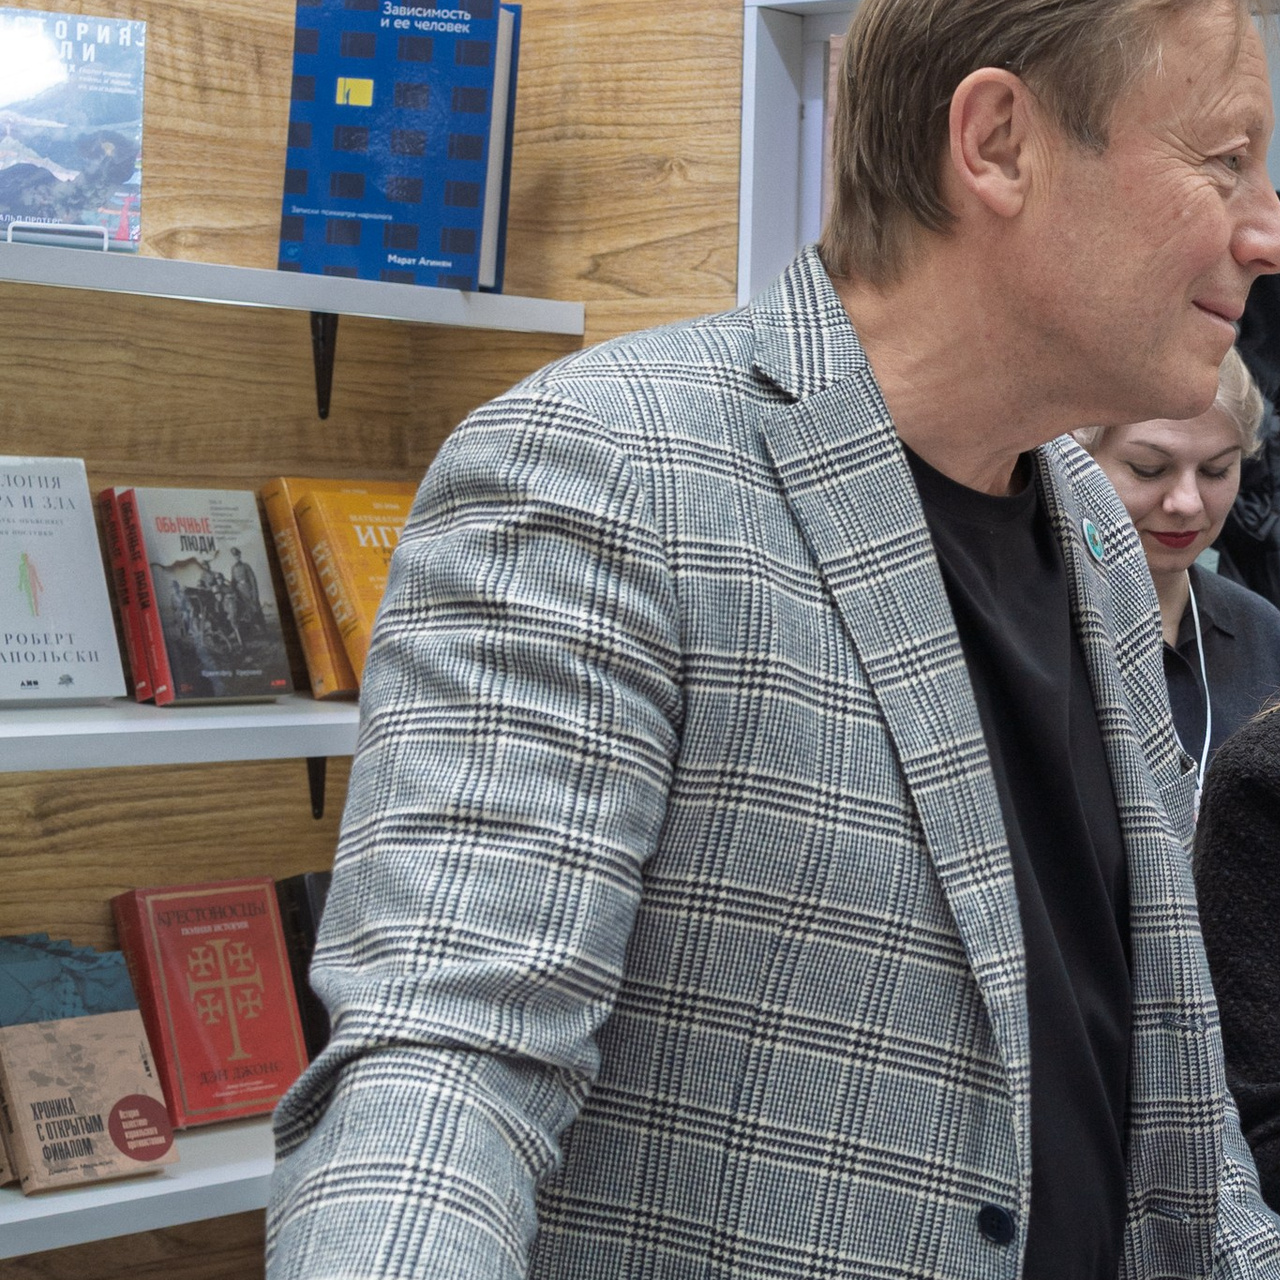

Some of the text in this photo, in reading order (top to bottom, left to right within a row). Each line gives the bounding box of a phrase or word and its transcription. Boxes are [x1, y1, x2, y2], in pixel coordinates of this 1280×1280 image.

[382, 1, 471, 21] Зависимость
[380, 19, 470, 33] и ее человек
[387, 254, 416, 266] Марат
[0, 474, 61, 489] ЛОГИЯ
[155, 516, 213, 534] ОБЫЧНЫЕ
[180, 534, 217, 554] ЛЮДИ
[353, 524, 404, 548] ИГ
[4, 633, 77, 645] РОБЕРТ
[0, 651, 99, 663] АПОЛЬСКИ
[30, 1097, 77, 1120] ХРОНИКА
[36, 1114, 104, 1141] С ОТКРЫТЫМ
[42, 1137, 95, 1162] ФИНАЛОМ
